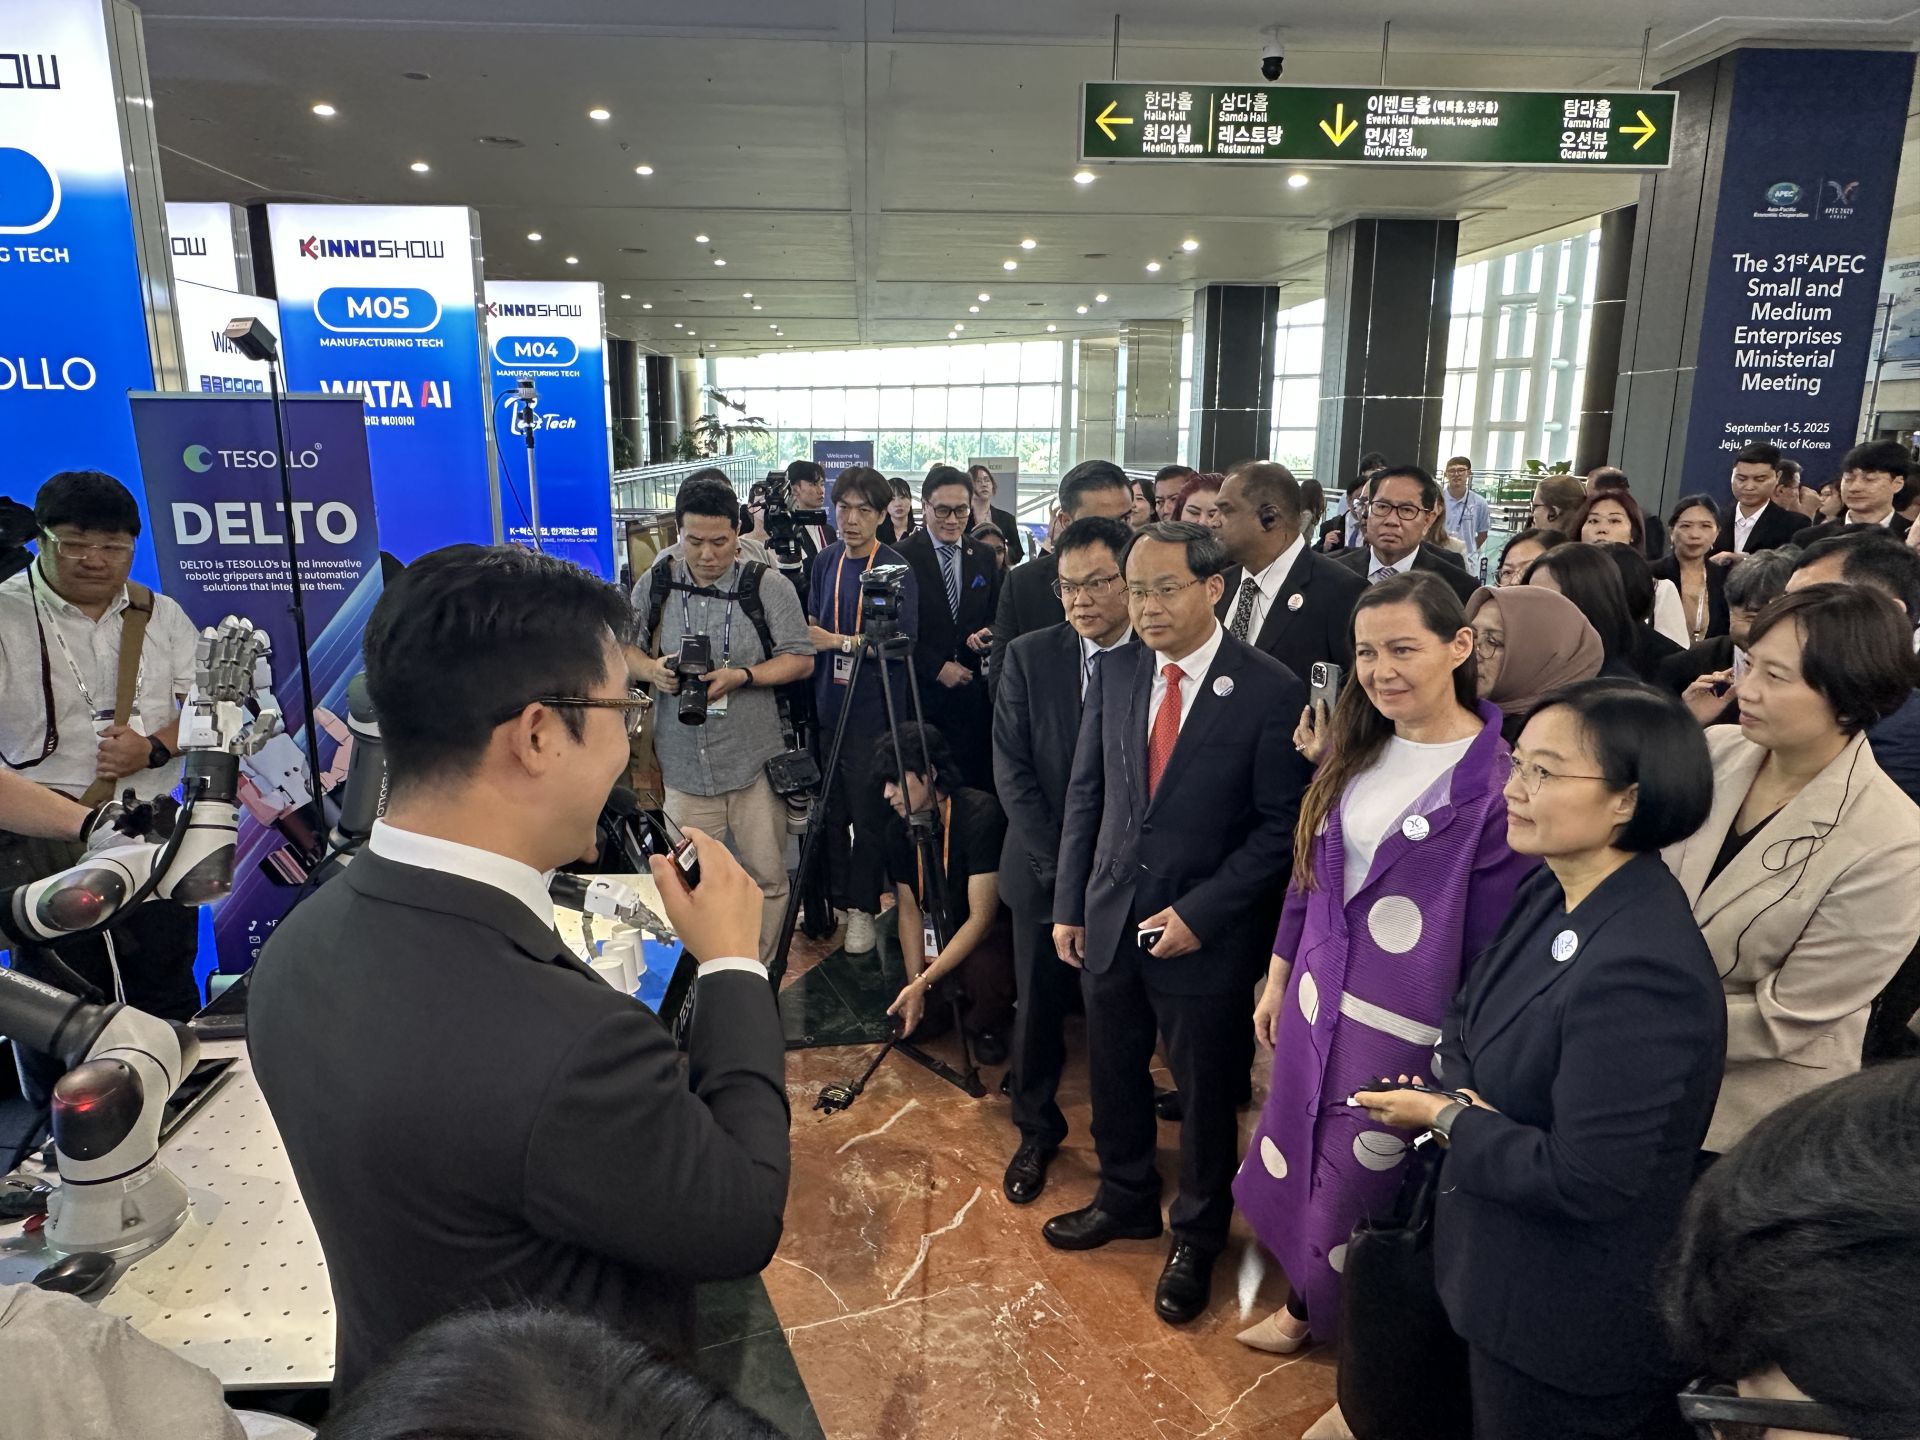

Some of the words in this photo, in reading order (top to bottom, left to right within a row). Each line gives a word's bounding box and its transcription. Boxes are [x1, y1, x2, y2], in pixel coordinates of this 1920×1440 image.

[1145, 91, 1193, 110] 한라홀
[1220, 92, 1268, 111] 삼다홀
[1367, 95, 1431, 115] 이벤트홀
[1564, 99, 1611, 118] 탐라홀
[1144, 110, 1167, 121] Halla
[1168, 110, 1186, 121] Hall
[1219, 111, 1248, 122] Samda
[1249, 112, 1267, 122] Hall
[1366, 114, 1390, 124] Event
[1391, 115, 1409, 125] Hall
[1563, 118, 1591, 128] Tamna
[1592, 118, 1610, 128] Hall
[1142, 123, 1191, 143] 회의실
[1218, 124, 1283, 145] 레스토랑
[1365, 127, 1413, 146] 면세점
[1560, 132, 1608, 150] 오션뷰
[1142, 142, 1176, 155] Meeting
[1178, 143, 1203, 153] Room
[1217, 143, 1264, 154] Restaurant
[1364, 145, 1384, 157] Duty
[1385, 146, 1404, 156] Free
[1405, 146, 1427, 158] Shop
[1561, 149, 1586, 159] Ocean
[1588, 150, 1607, 159] view
[14, 247, 70, 263] TECH
[1732, 254, 1767, 272] The
[1808, 255, 1866, 274] APEC
[1747, 278, 1800, 297] Small
[1805, 279, 1843, 297] and
[347, 296, 410, 319] M05
[1751, 302, 1832, 321] Medium
[320, 338, 413, 348] MANUFACTURING
[415, 338, 444, 348] TECH
[1734, 326, 1842, 349] Enterprises
[514, 342, 558, 357] M04
[1735, 349, 1835, 368] Ministerial
[1741, 373, 1821, 396] Meeting
[421, 381, 452, 408] AI
[543, 413, 576, 430] Tech
[1725, 422, 1781, 435] September
[1783, 423, 1802, 433] 1-5,
[1803, 423, 1830, 433] 2025
[1719, 440, 1742, 451] Jeju,
[1789, 438, 1801, 449] of
[1802, 439, 1831, 449] Korea
[218, 450, 319, 468] TESOLO
[171, 501, 358, 545] DELTO
[180, 560, 213, 569] DELTO
[215, 560, 224, 569] is
[225, 559, 280, 569] TESOLLO's
[281, 559, 310, 569] brnd
[312, 558, 362, 569] innovative
[185, 571, 221, 580] robotic
[223, 571, 263, 582] grippers
[265, 571, 284, 580] and
[304, 570, 359, 579] automation
[203, 582, 248, 591] solutions
[249, 582, 269, 591] that
[317, 581, 345, 591] them.
